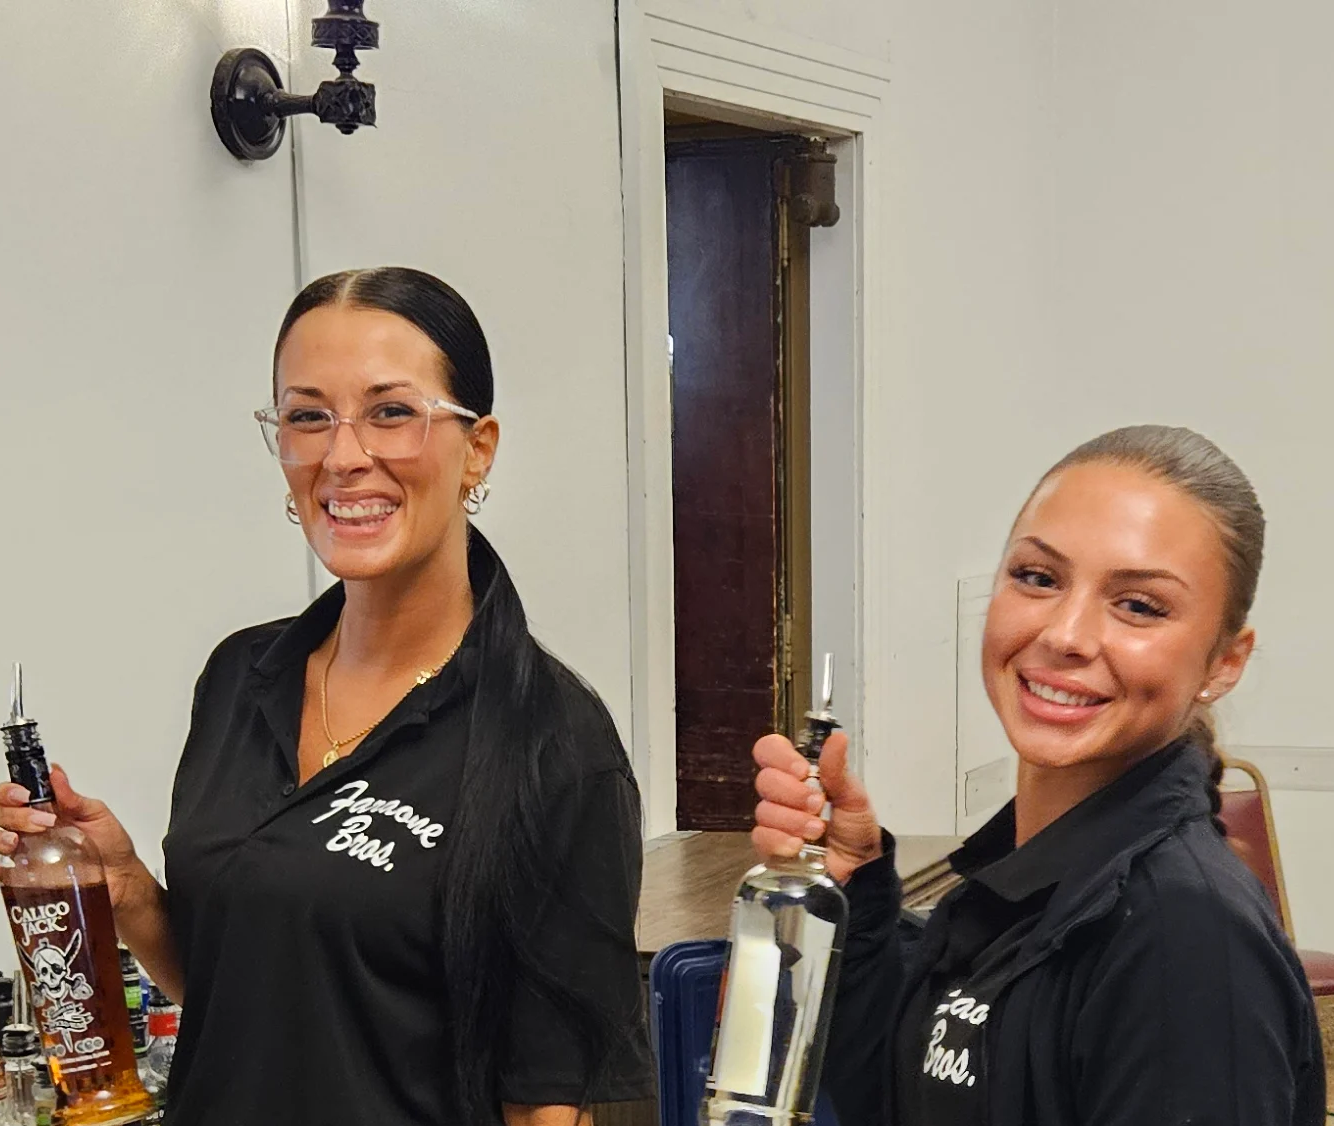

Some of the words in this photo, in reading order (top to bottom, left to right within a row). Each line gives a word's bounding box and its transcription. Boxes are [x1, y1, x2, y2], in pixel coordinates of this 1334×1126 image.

[326, 814, 395, 872] Bros.
[10, 901, 70, 924] CALICO
[21, 916, 68, 946] JACK
